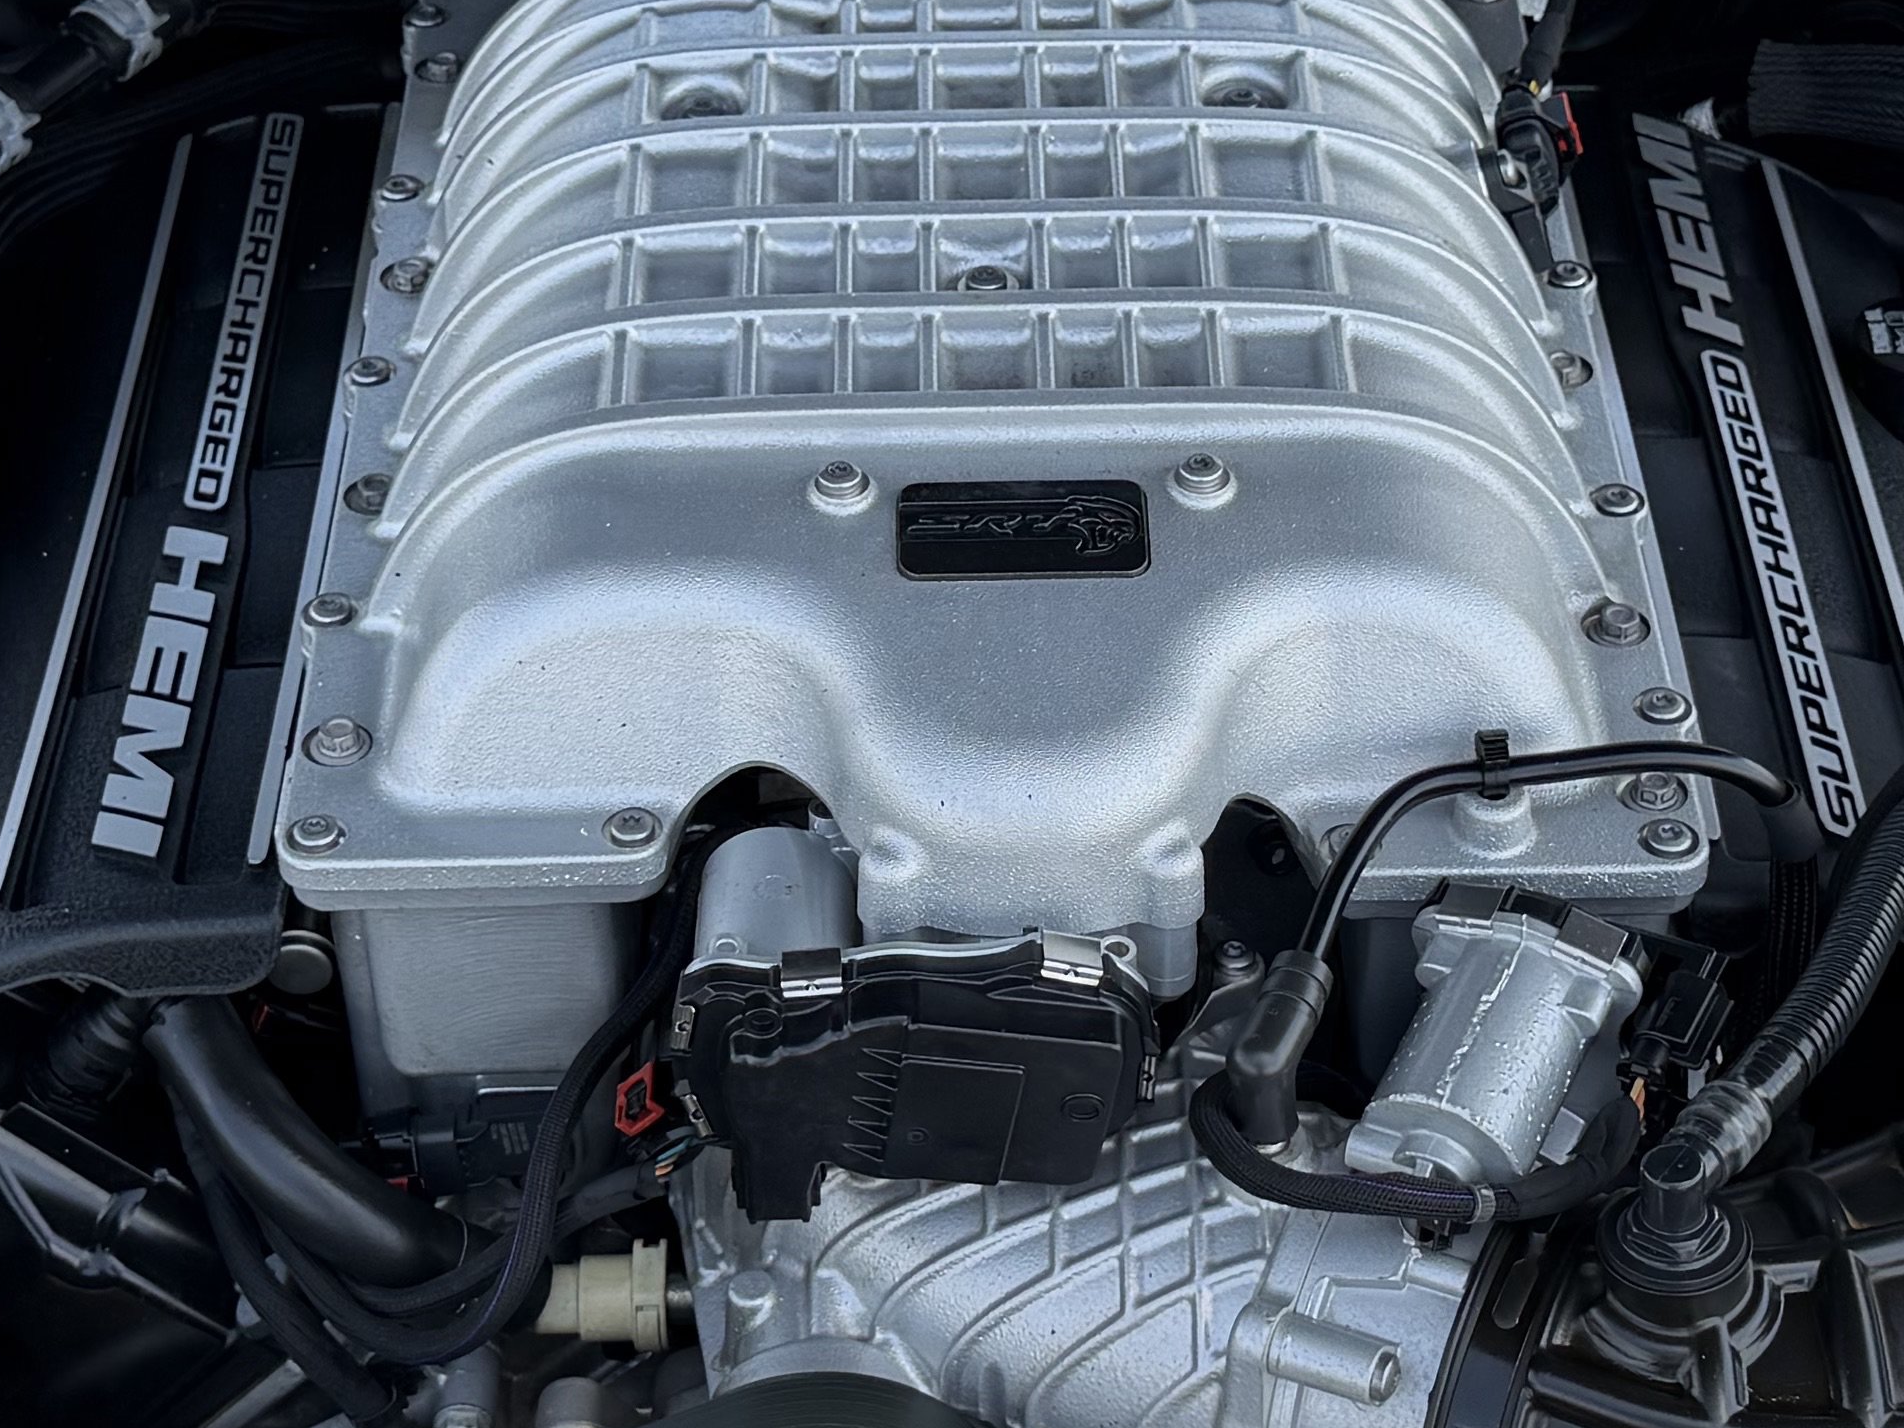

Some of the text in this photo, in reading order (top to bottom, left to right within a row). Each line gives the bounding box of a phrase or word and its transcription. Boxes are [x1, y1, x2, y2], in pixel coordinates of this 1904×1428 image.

[91, 114, 299, 859] SUPERCHARGED HEMI
[906, 505, 1084, 536] SRT
[1632, 112, 1861, 834] SUPERCHARGED HEMI
